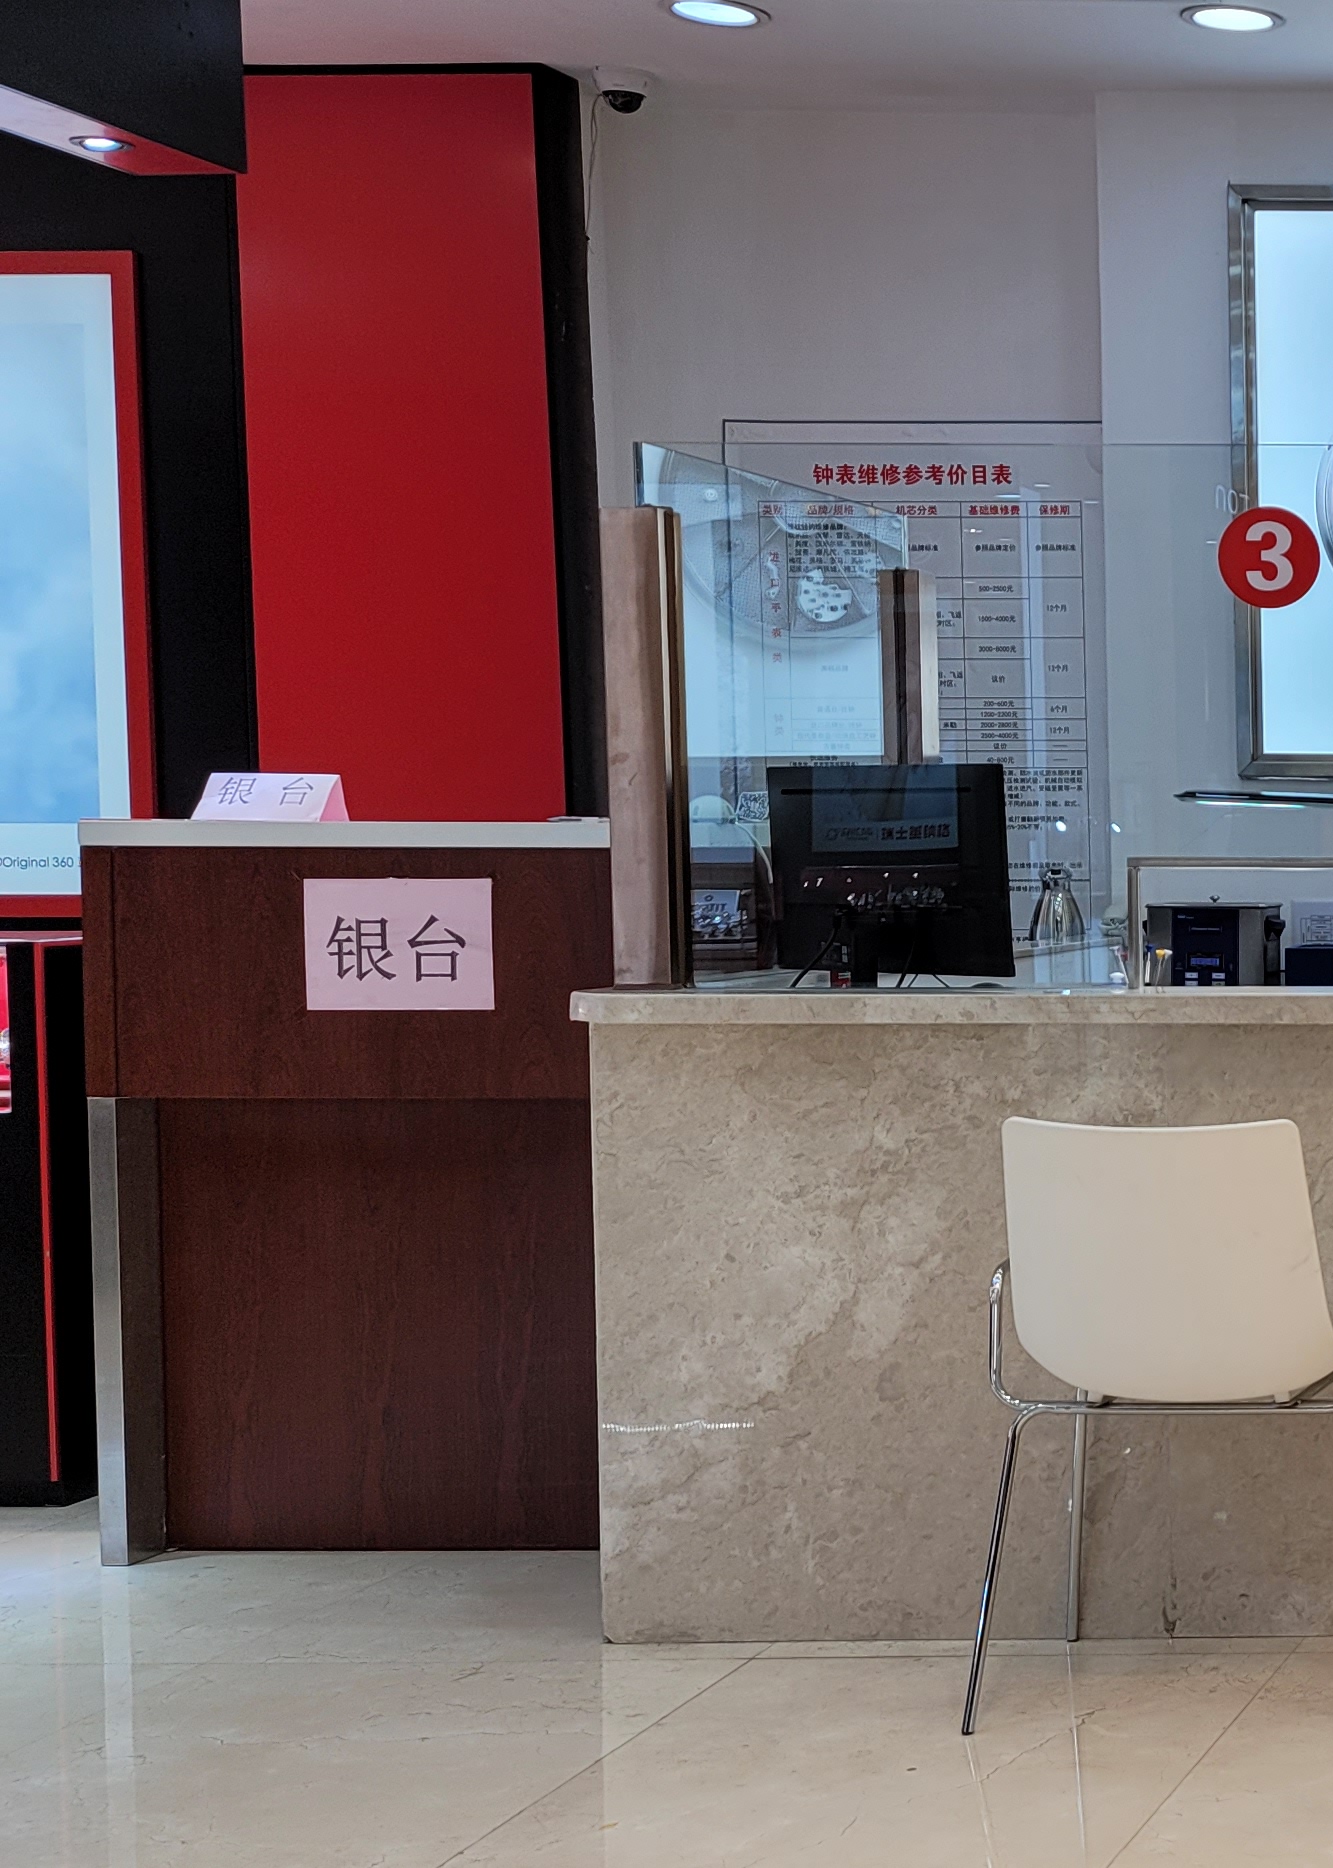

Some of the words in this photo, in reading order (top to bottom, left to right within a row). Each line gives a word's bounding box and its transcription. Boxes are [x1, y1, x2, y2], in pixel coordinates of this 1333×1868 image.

[813, 464, 1013, 486] 钟表维修参考价目表
[896, 505, 937, 516] 机芯分类
[968, 504, 1020, 516] 基础维修费
[1039, 504, 1070, 515] 保修期
[908, 544, 939, 552] 品牌标准
[1245, 520, 1294, 591] 3
[217, 776, 314, 806] 银台
[0, 856, 50, 870] Original
[52, 856, 74, 868] 360
[325, 914, 467, 983] 银台
